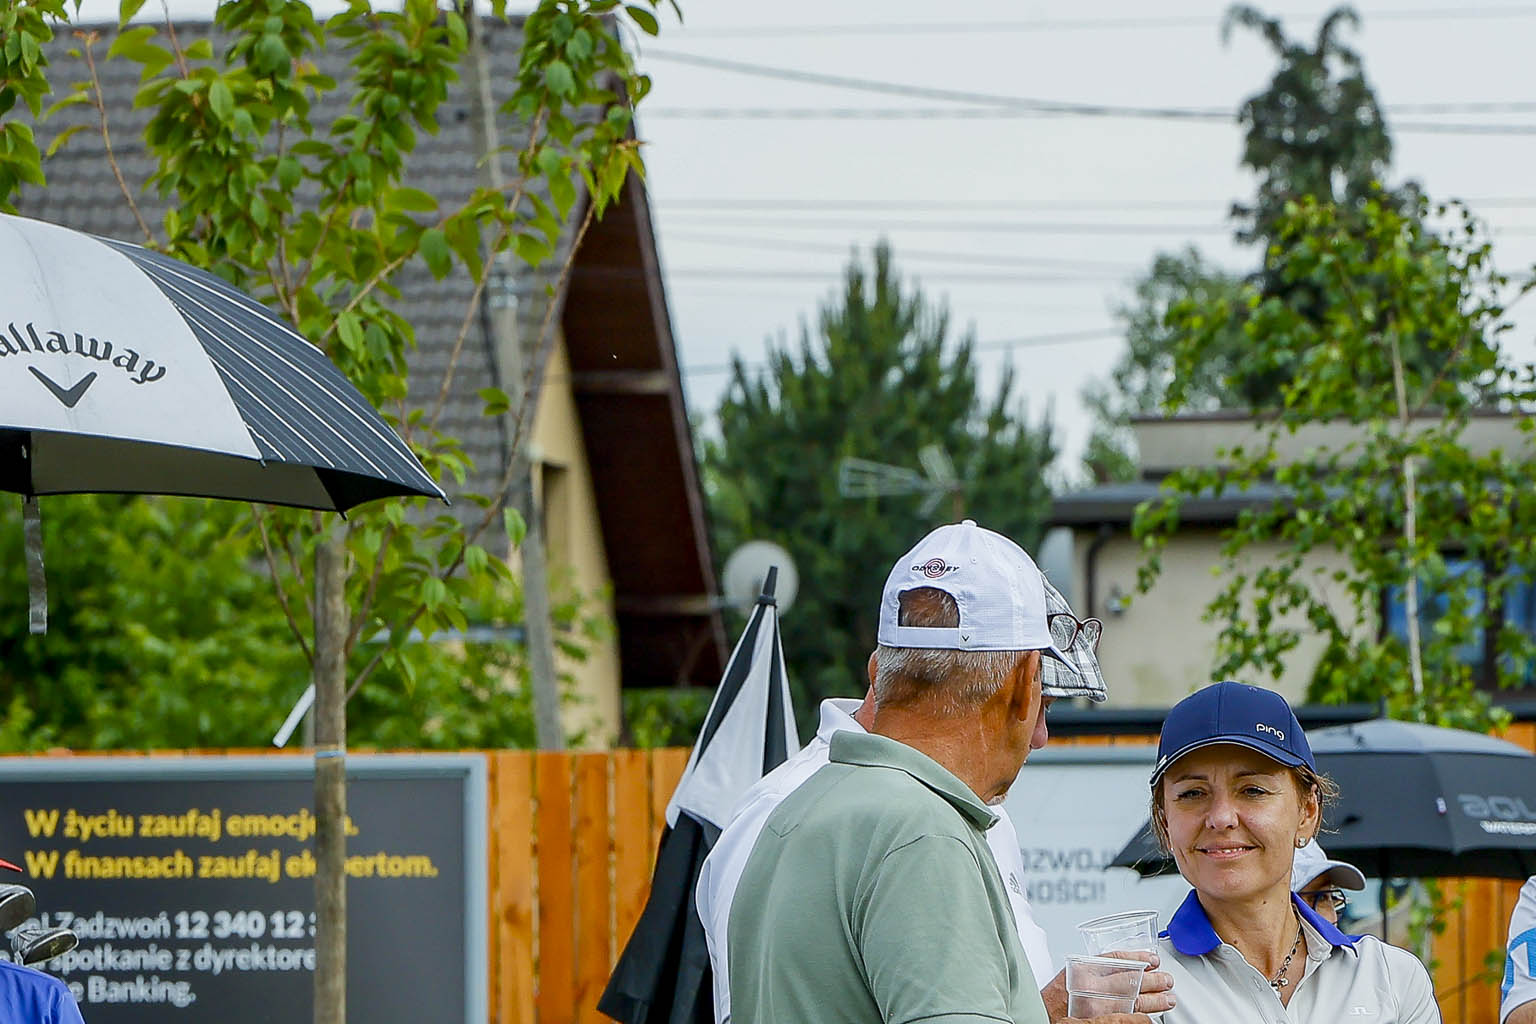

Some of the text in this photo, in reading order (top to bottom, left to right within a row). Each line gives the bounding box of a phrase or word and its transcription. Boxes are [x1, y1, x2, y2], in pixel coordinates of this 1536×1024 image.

[1256, 723, 1285, 741] ping
[24, 808, 359, 842] W życiu zaufaj emocj.
[24, 849, 439, 883] W finansach zaufaj ekertom.
[54, 910, 171, 938] Zadzwoń
[175, 911, 209, 938] 12
[213, 911, 266, 938] 340
[270, 911, 305, 938] 12
[176, 949, 191, 971] z
